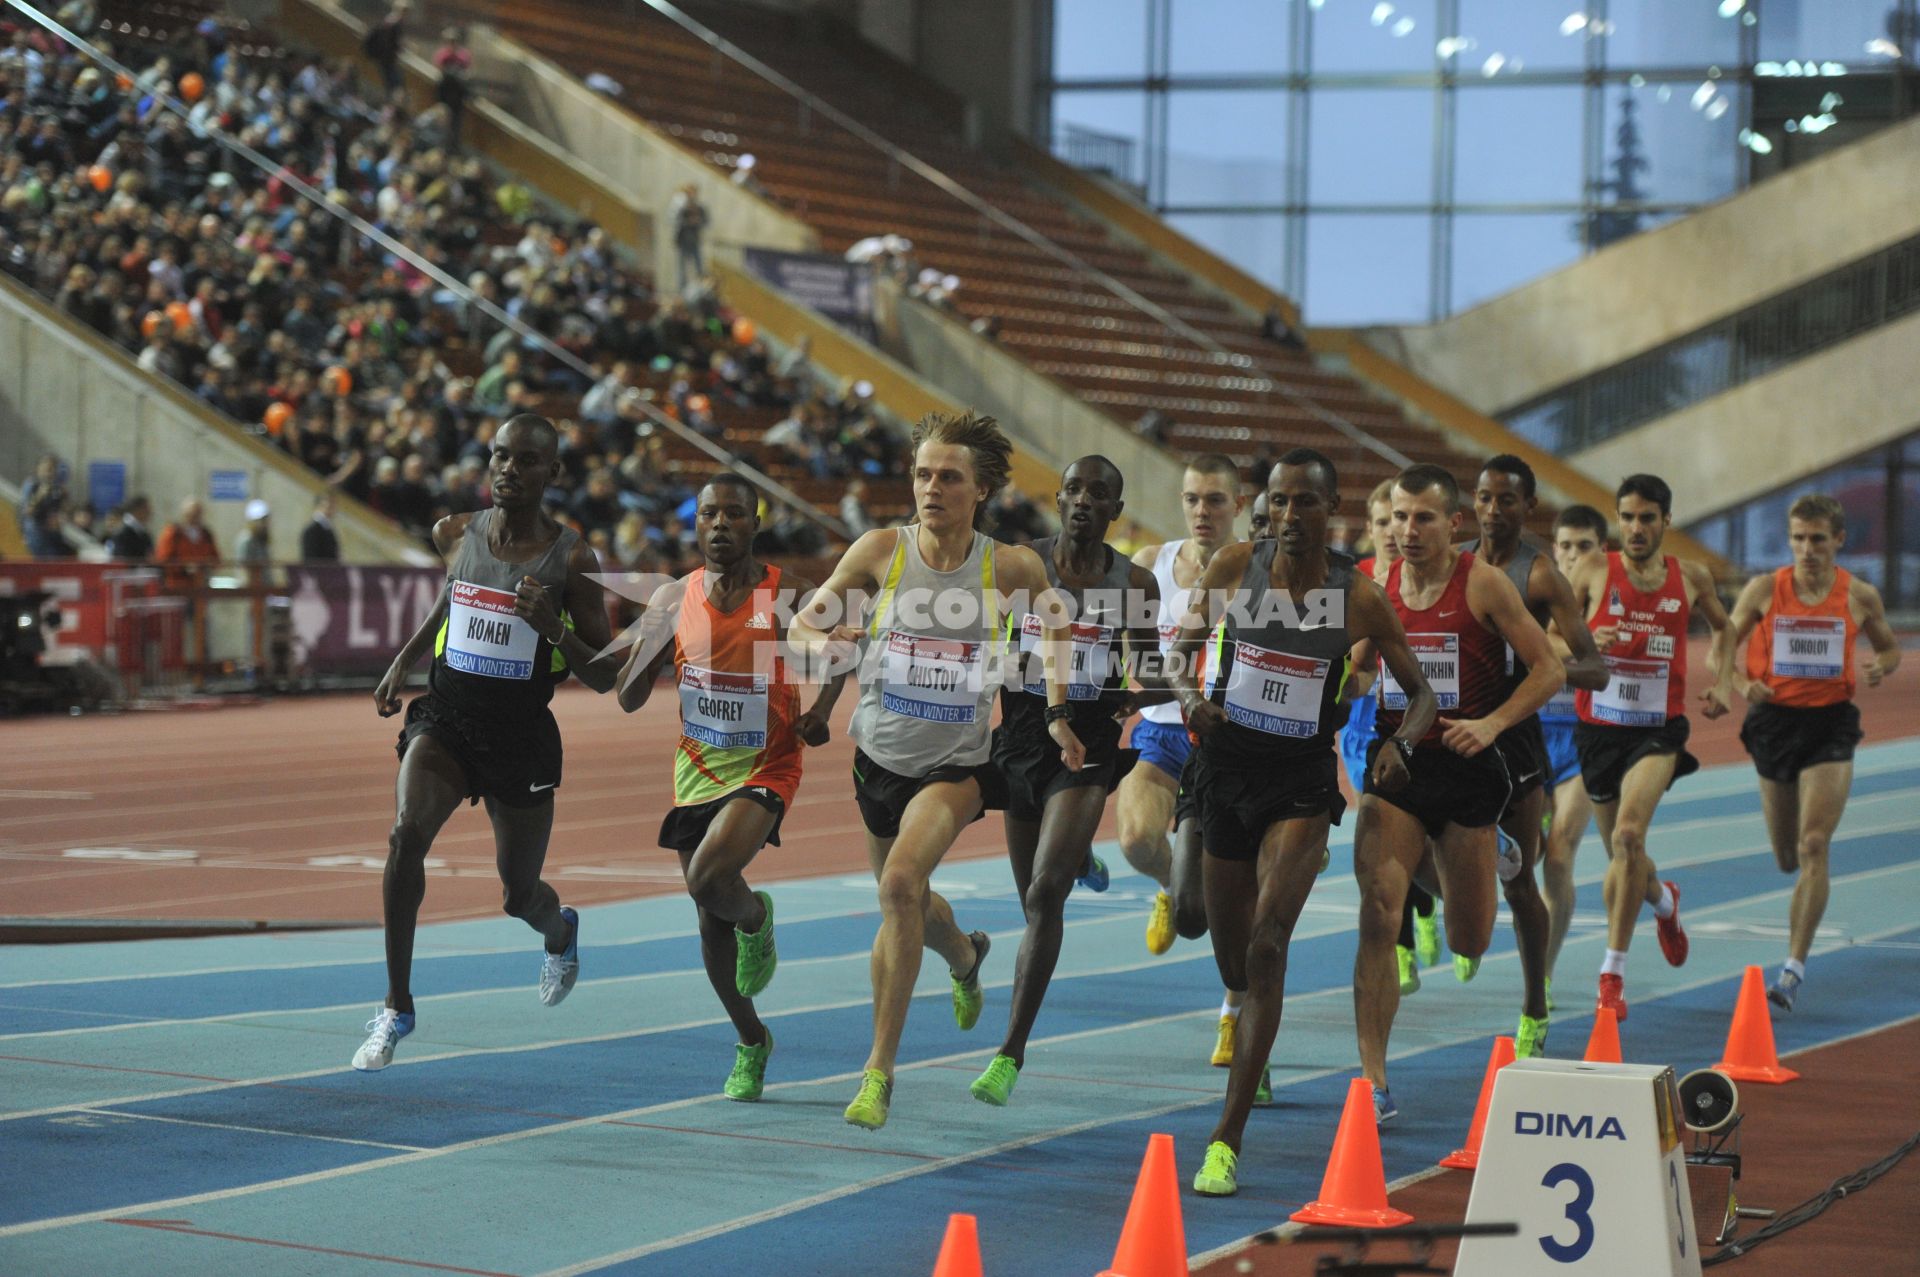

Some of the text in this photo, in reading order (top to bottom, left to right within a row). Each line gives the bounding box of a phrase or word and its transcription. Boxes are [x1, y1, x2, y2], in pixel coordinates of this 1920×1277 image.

[455, 585, 480, 597] IAAF
[453, 595, 472, 606] Indoor
[473, 600, 497, 611] Permit
[1630, 610, 1656, 622] new
[467, 616, 511, 646] KOMEN
[1617, 619, 1666, 633] balance
[892, 634, 919, 645] IAAF
[1789, 638, 1829, 656] SOKOLOV
[891, 643, 969, 662] Indoor Permit Meeting
[1237, 645, 1265, 658] IAAF
[479, 658, 516, 677] WINTER
[685, 667, 706, 678] IAAF
[1237, 655, 1312, 678] Indoor Permit Meeting
[700, 681, 724, 691] Permit
[724, 684, 752, 694] Meeting
[907, 664, 959, 692] CHISTOV
[1261, 679, 1290, 705] FETE
[1618, 683, 1641, 702] RUIZ
[697, 697, 744, 721] GEOFREY
[883, 694, 974, 721] RUSSIAN WINTER '13
[1226, 703, 1262, 727] RUSSIAN
[1264, 716, 1300, 735] WINTER
[684, 721, 764, 747] RUSSIAN WINTER '13
[1514, 1111, 1627, 1141] DIMA
[1538, 1162, 1595, 1263] 3
